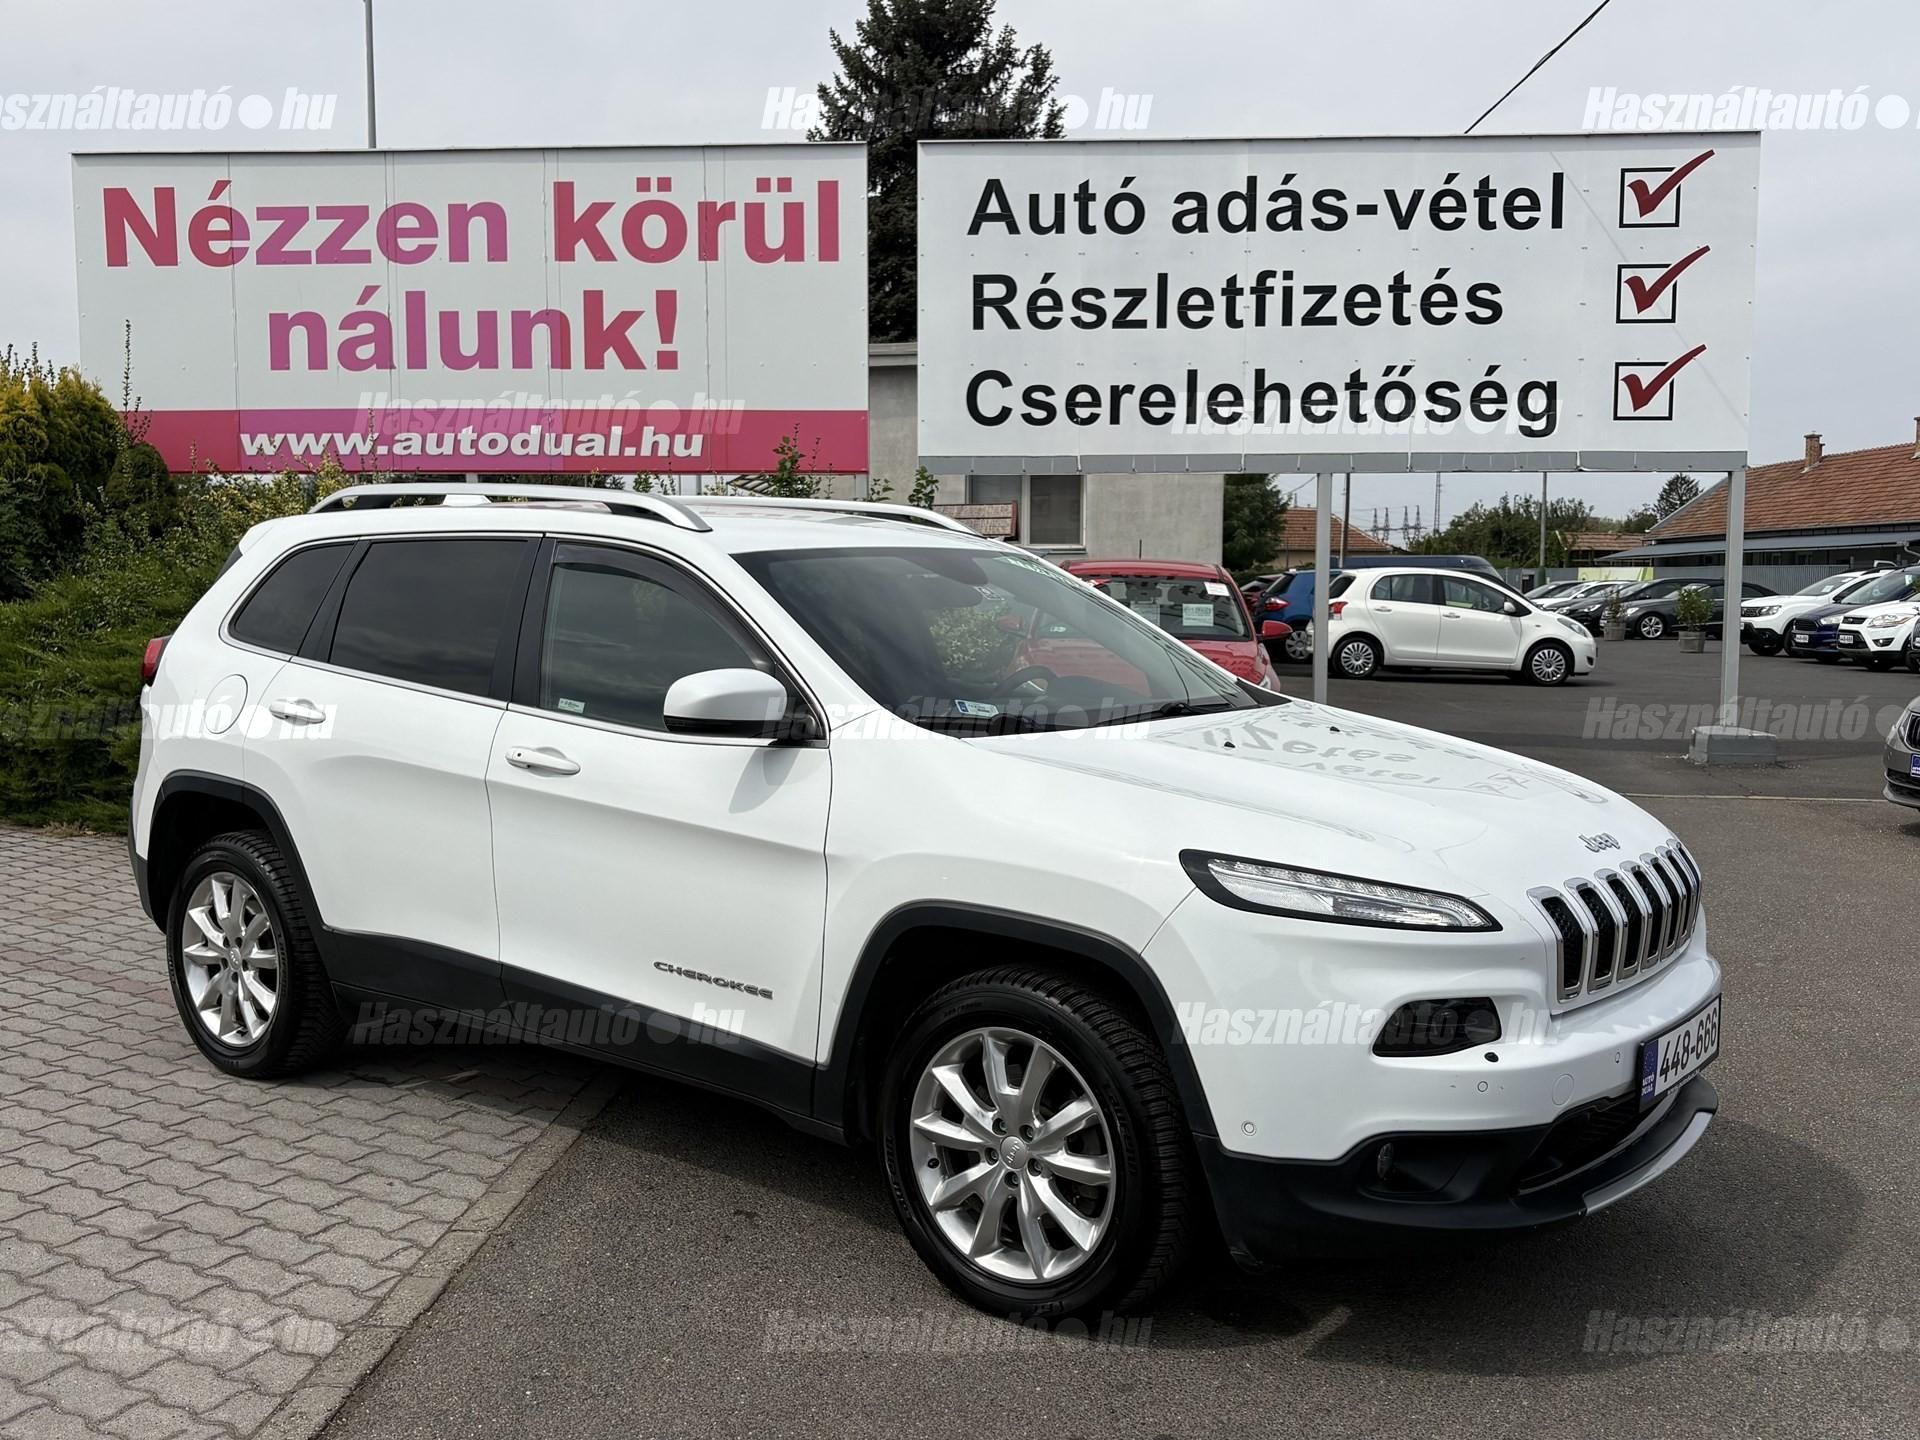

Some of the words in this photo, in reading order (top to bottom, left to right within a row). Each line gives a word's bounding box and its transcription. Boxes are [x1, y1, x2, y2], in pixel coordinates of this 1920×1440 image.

[103, 179, 508, 268] Nézzen
[553, 176, 840, 264] körül
[967, 176, 1146, 236] Autó
[1171, 172, 1565, 234] adás-vétel
[269, 285, 679, 371] nálunk!
[972, 267, 1504, 331] Részletfizetés
[966, 364, 1558, 438] Cserelehetőség
[240, 425, 704, 457] www.autodual.hu
[1578, 833, 1621, 853] Jeep
[653, 961, 773, 1000] CHEROKEE
[1659, 1007, 1718, 1083] 448-666
